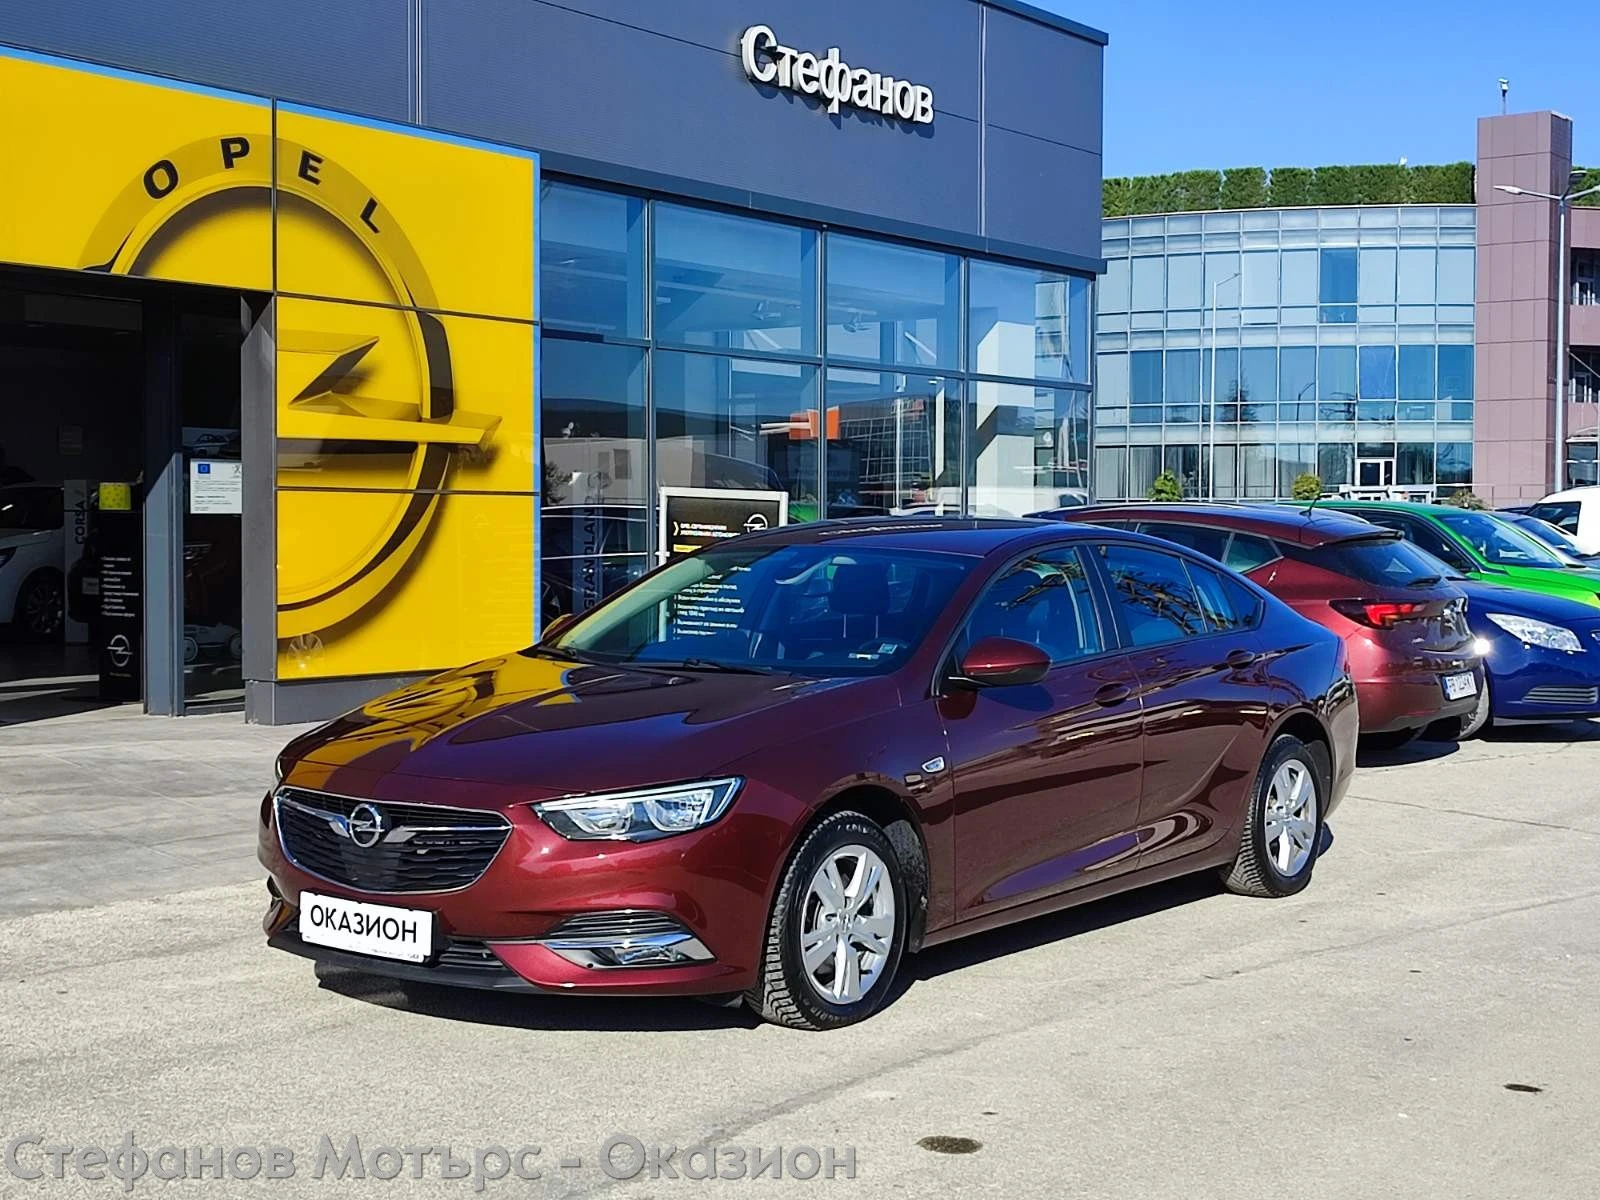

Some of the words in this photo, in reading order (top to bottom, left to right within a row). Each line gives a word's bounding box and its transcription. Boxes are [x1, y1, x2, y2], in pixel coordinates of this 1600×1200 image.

[741, 25, 934, 123] Стефанов
[143, 136, 381, 234] OPEL
[75, 500, 85, 544] CORSA
[310, 904, 417, 943] ОКАЗИОН
